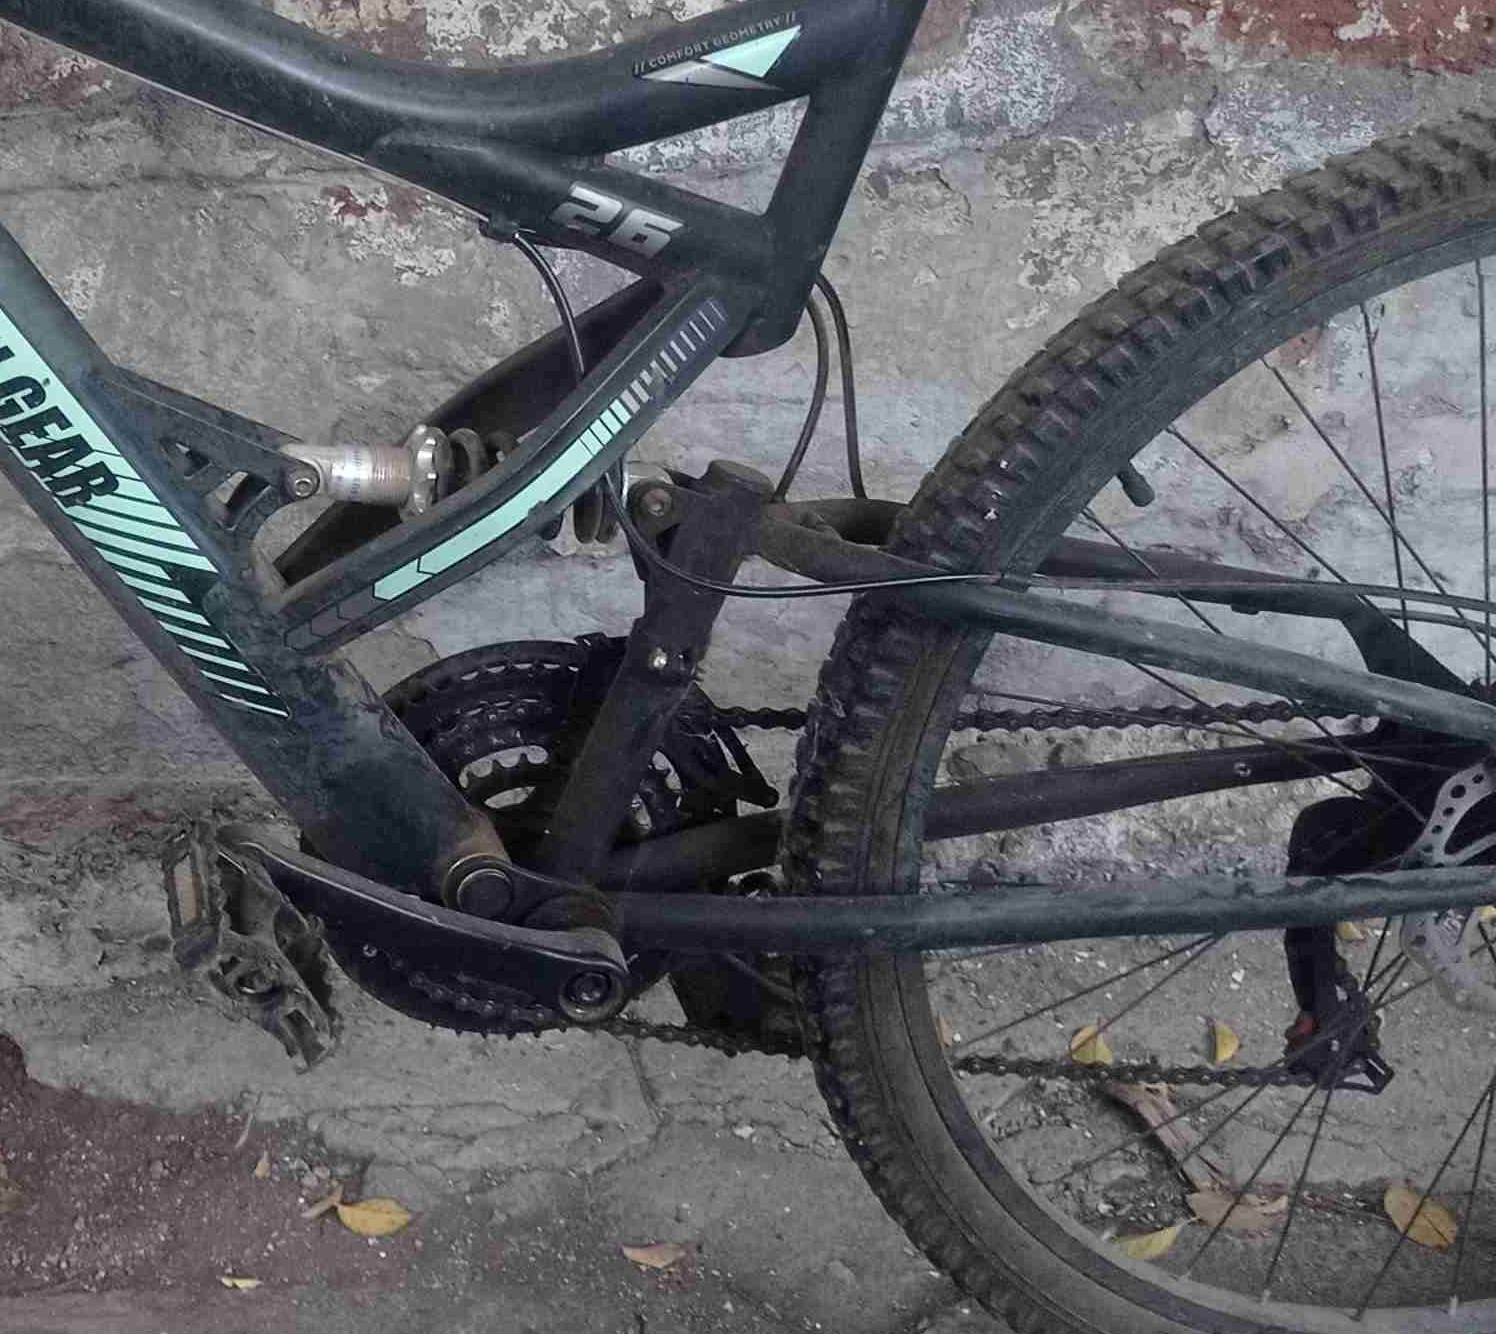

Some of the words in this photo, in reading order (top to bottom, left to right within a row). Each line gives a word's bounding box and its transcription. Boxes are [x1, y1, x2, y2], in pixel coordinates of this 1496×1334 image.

[648, 41, 710, 68] COMFORT
[712, 17, 785, 47] GEOMETRY
[551, 181, 686, 259] 26
